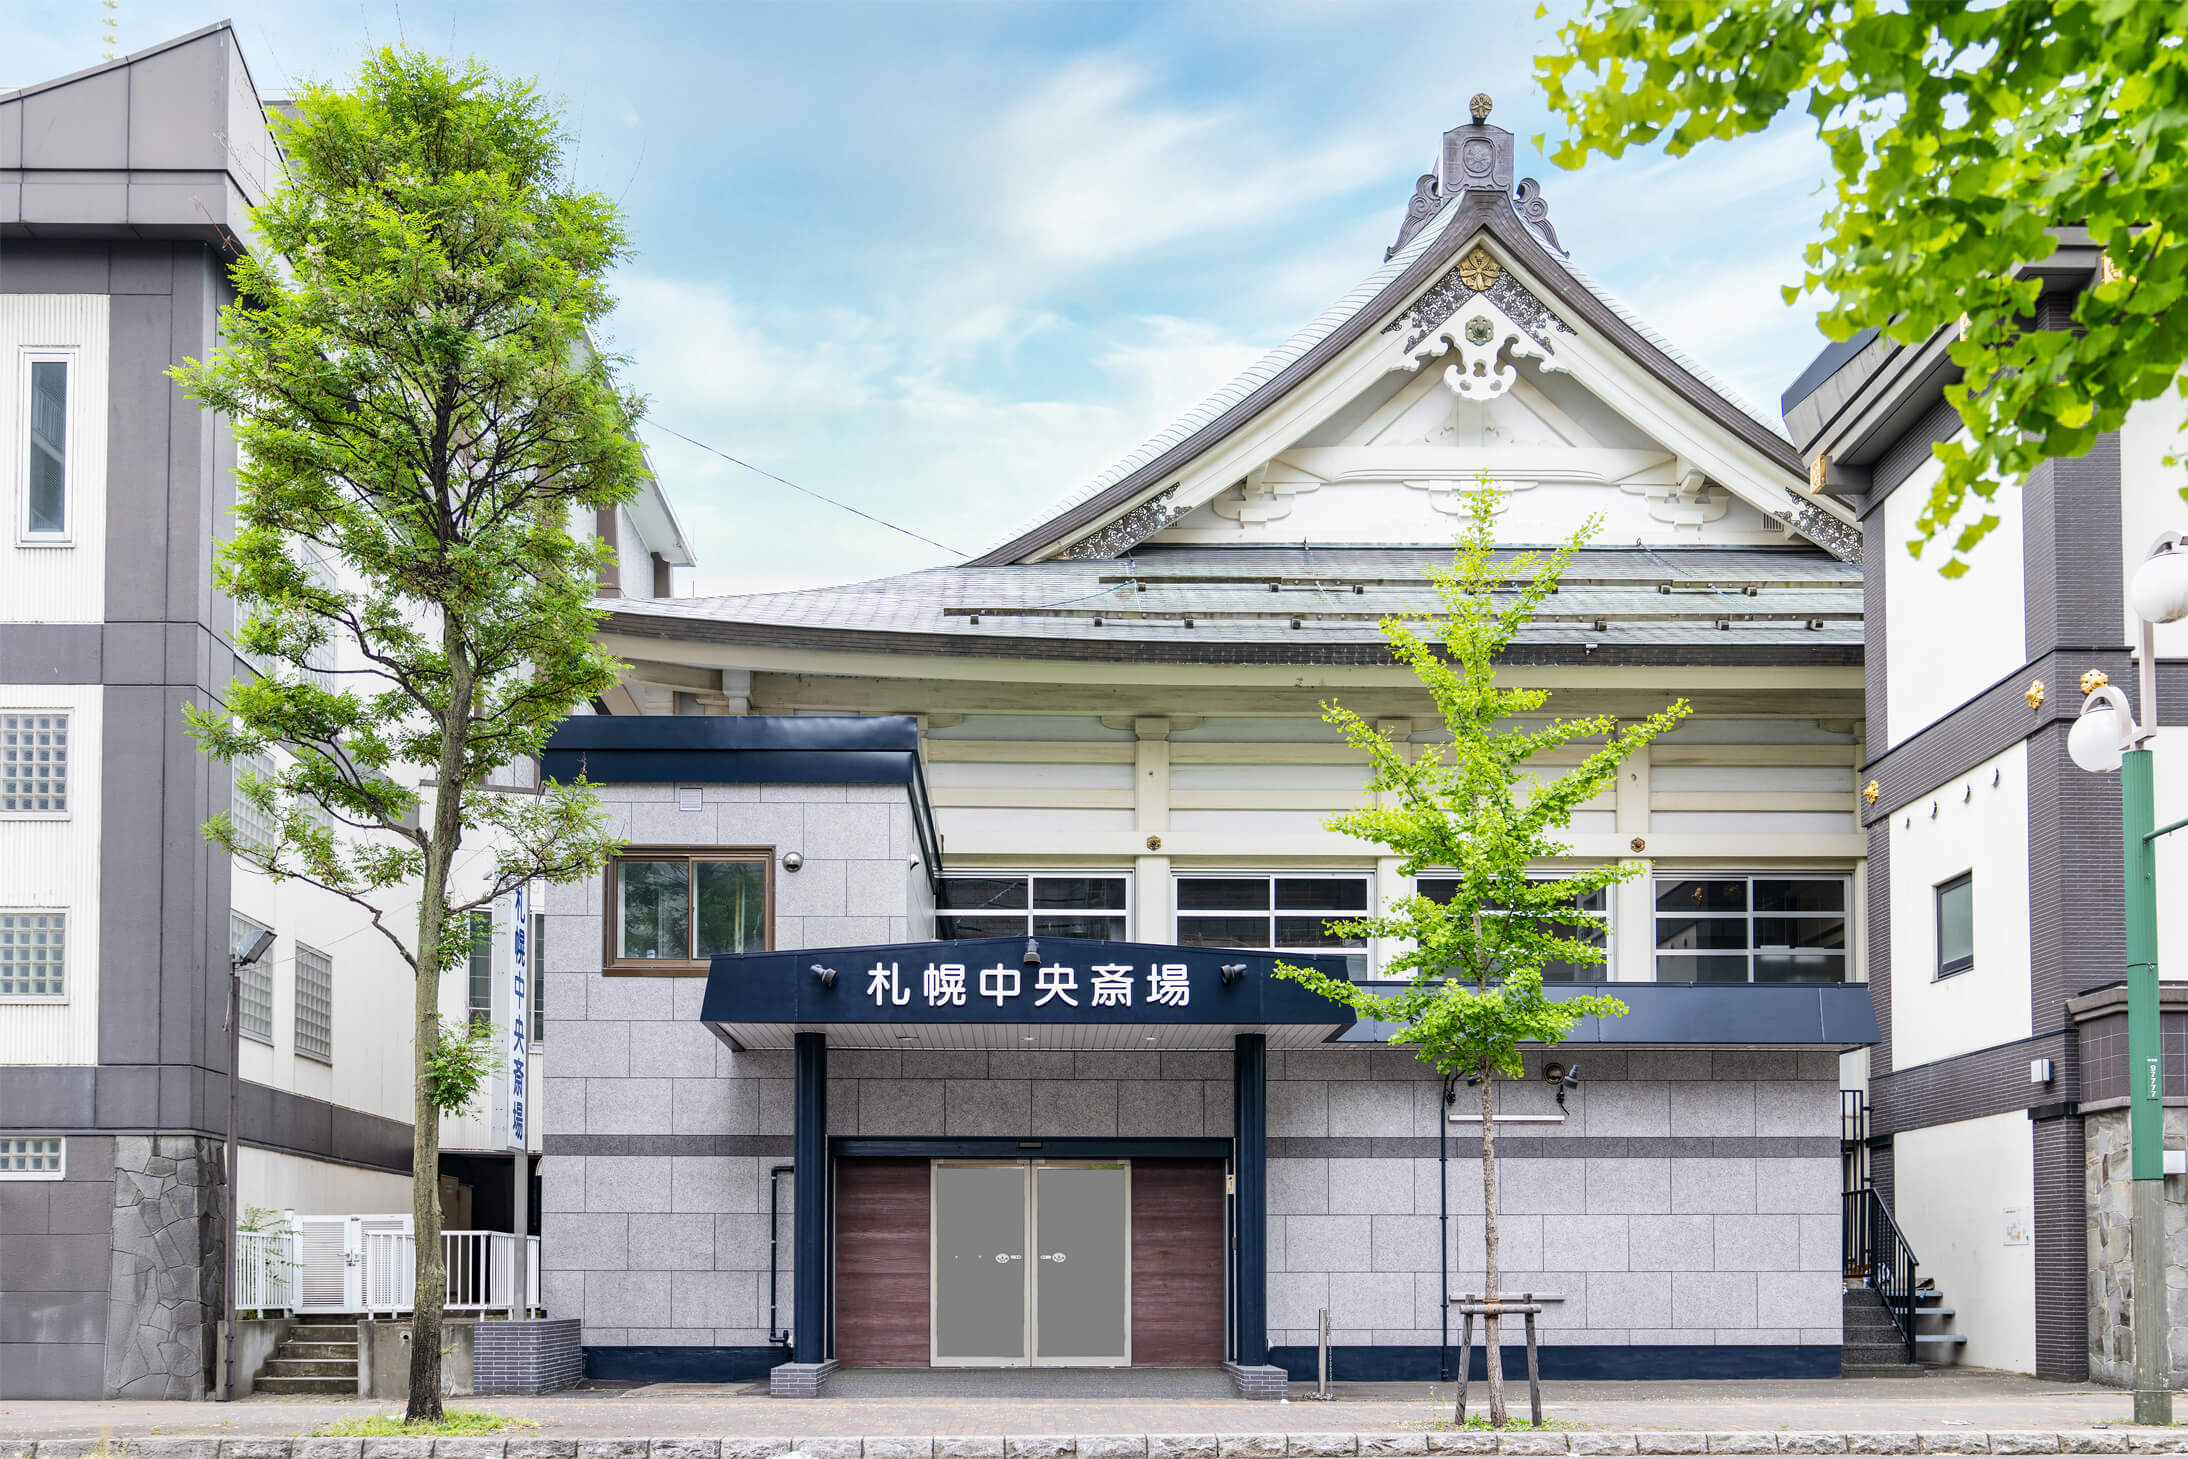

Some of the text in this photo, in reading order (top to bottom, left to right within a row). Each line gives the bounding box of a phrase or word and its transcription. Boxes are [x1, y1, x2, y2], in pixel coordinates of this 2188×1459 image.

[866, 962, 1191, 1008] 札幌中央斎場
